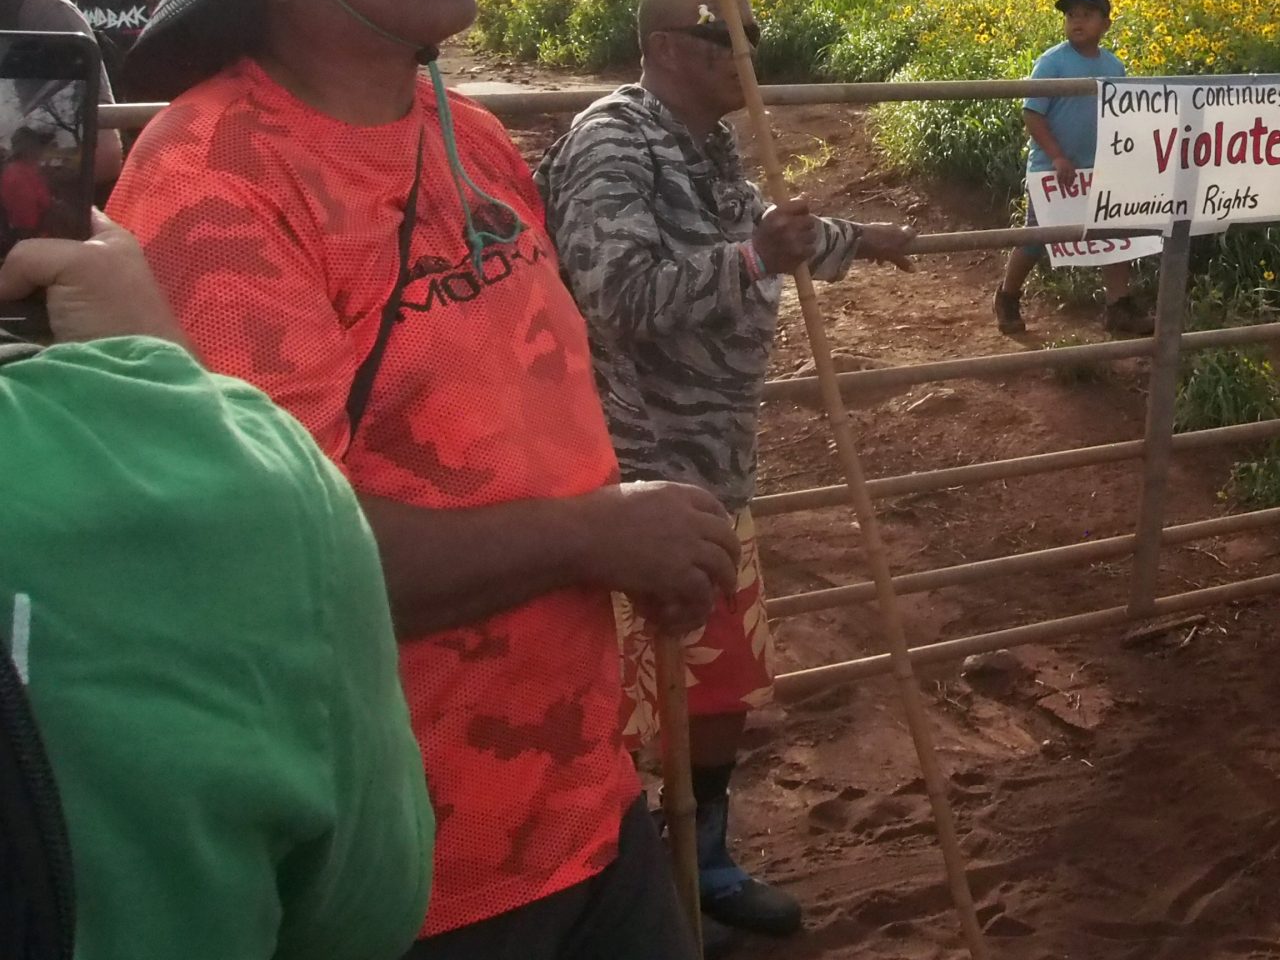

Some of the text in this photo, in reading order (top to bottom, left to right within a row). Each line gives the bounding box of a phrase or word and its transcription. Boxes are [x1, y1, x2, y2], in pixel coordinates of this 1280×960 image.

[1101, 81, 1178, 118] Ranch
[1111, 131, 1134, 155] to
[1095, 185, 1259, 223] Hawaiian Rights
